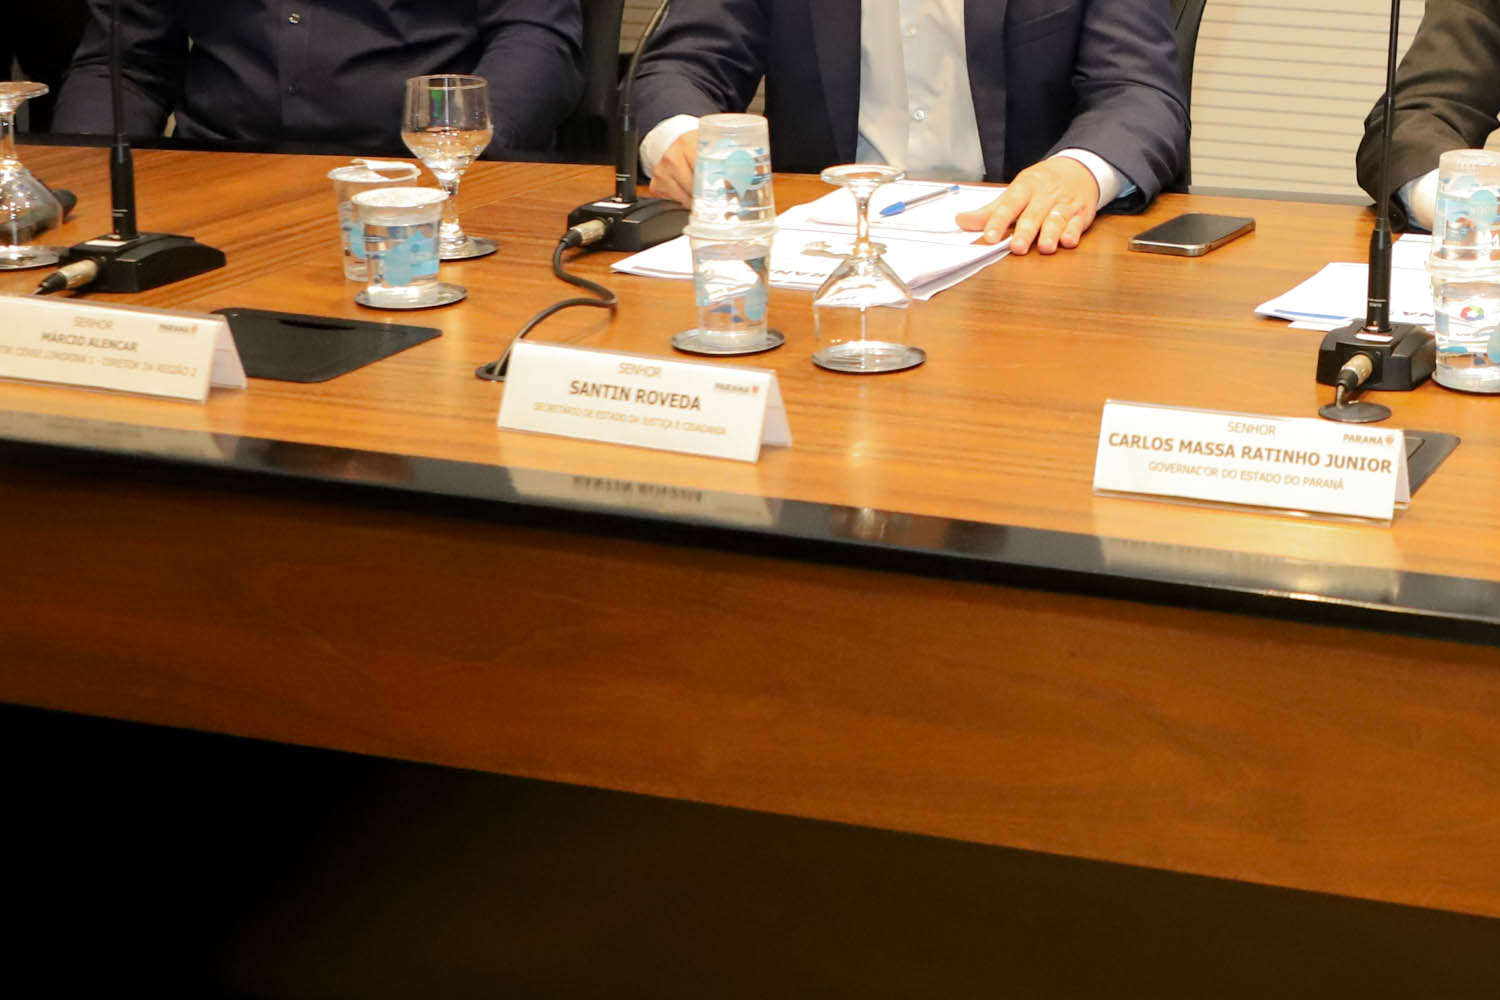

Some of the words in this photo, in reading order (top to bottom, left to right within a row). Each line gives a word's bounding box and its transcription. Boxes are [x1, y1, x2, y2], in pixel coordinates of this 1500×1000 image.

[618, 362, 662, 377] SENHOR
[569, 380, 630, 402] SANTIN
[635, 388, 701, 411] ROVEDA
[1227, 421, 1276, 435] SENHOR
[1108, 432, 1174, 452] CARLOS
[1178, 439, 1236, 458] MASSA
[1241, 446, 1321, 467] RATINHO
[1324, 454, 1393, 473] JUNIOR
[1221, 467, 1237, 480] DO
[1240, 469, 1281, 484] ESTADO
[1284, 473, 1300, 486] DO
[1303, 475, 1344, 490] PARANÁ
